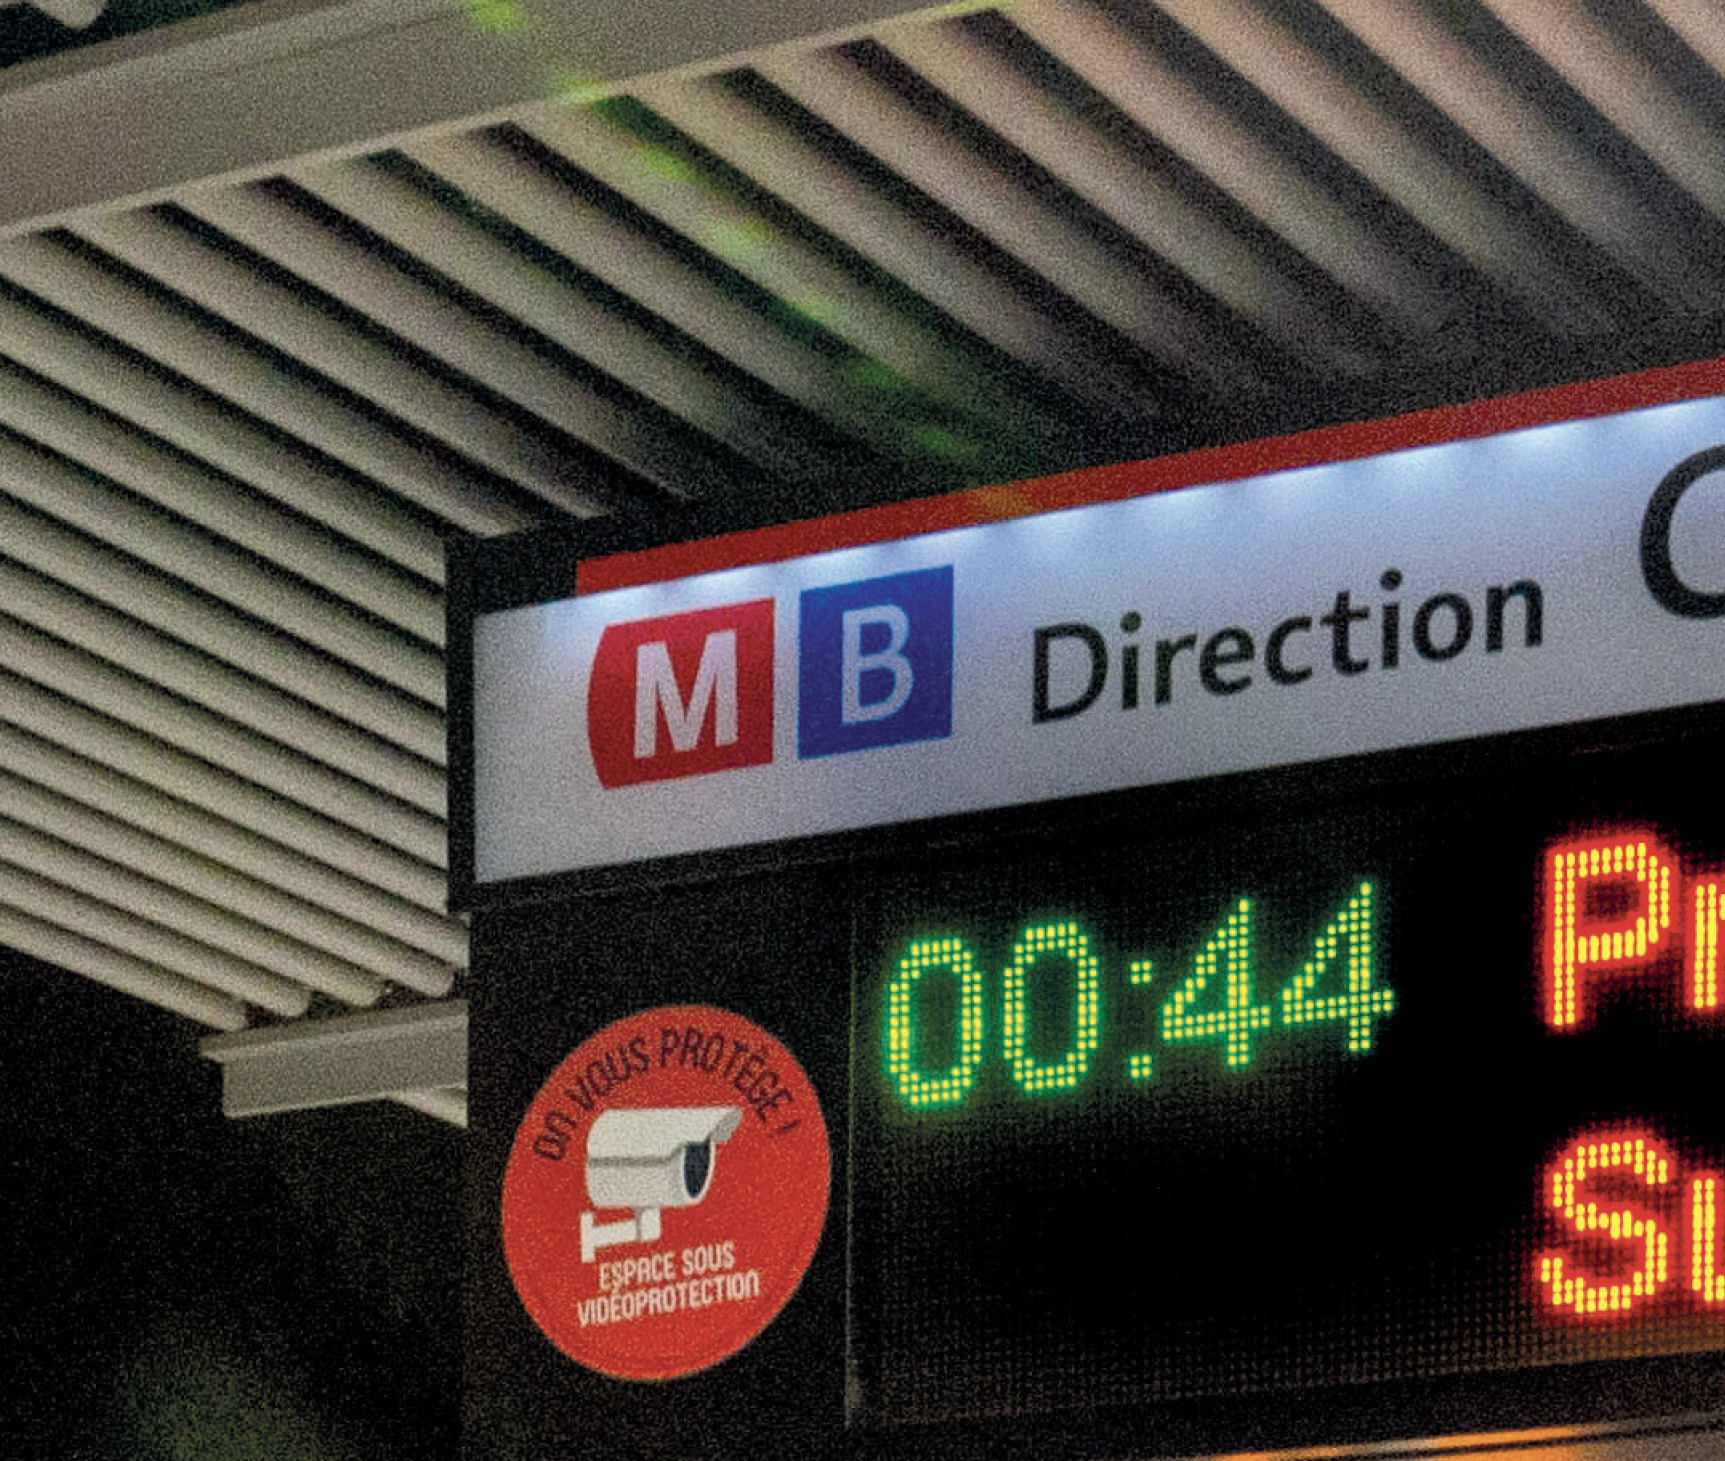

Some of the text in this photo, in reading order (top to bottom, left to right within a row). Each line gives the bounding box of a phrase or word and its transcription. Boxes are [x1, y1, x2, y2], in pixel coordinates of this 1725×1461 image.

[632, 631, 738, 759] M
[841, 605, 913, 726] B
[1031, 570, 1544, 724] Direction
[884, 881, 1394, 1107] 00:44
[564, 1036, 650, 1110] VOUS
[577, 1269, 760, 1328] VIDÉOPROTECTION
[599, 1240, 735, 1292] ESPACE SOUS
